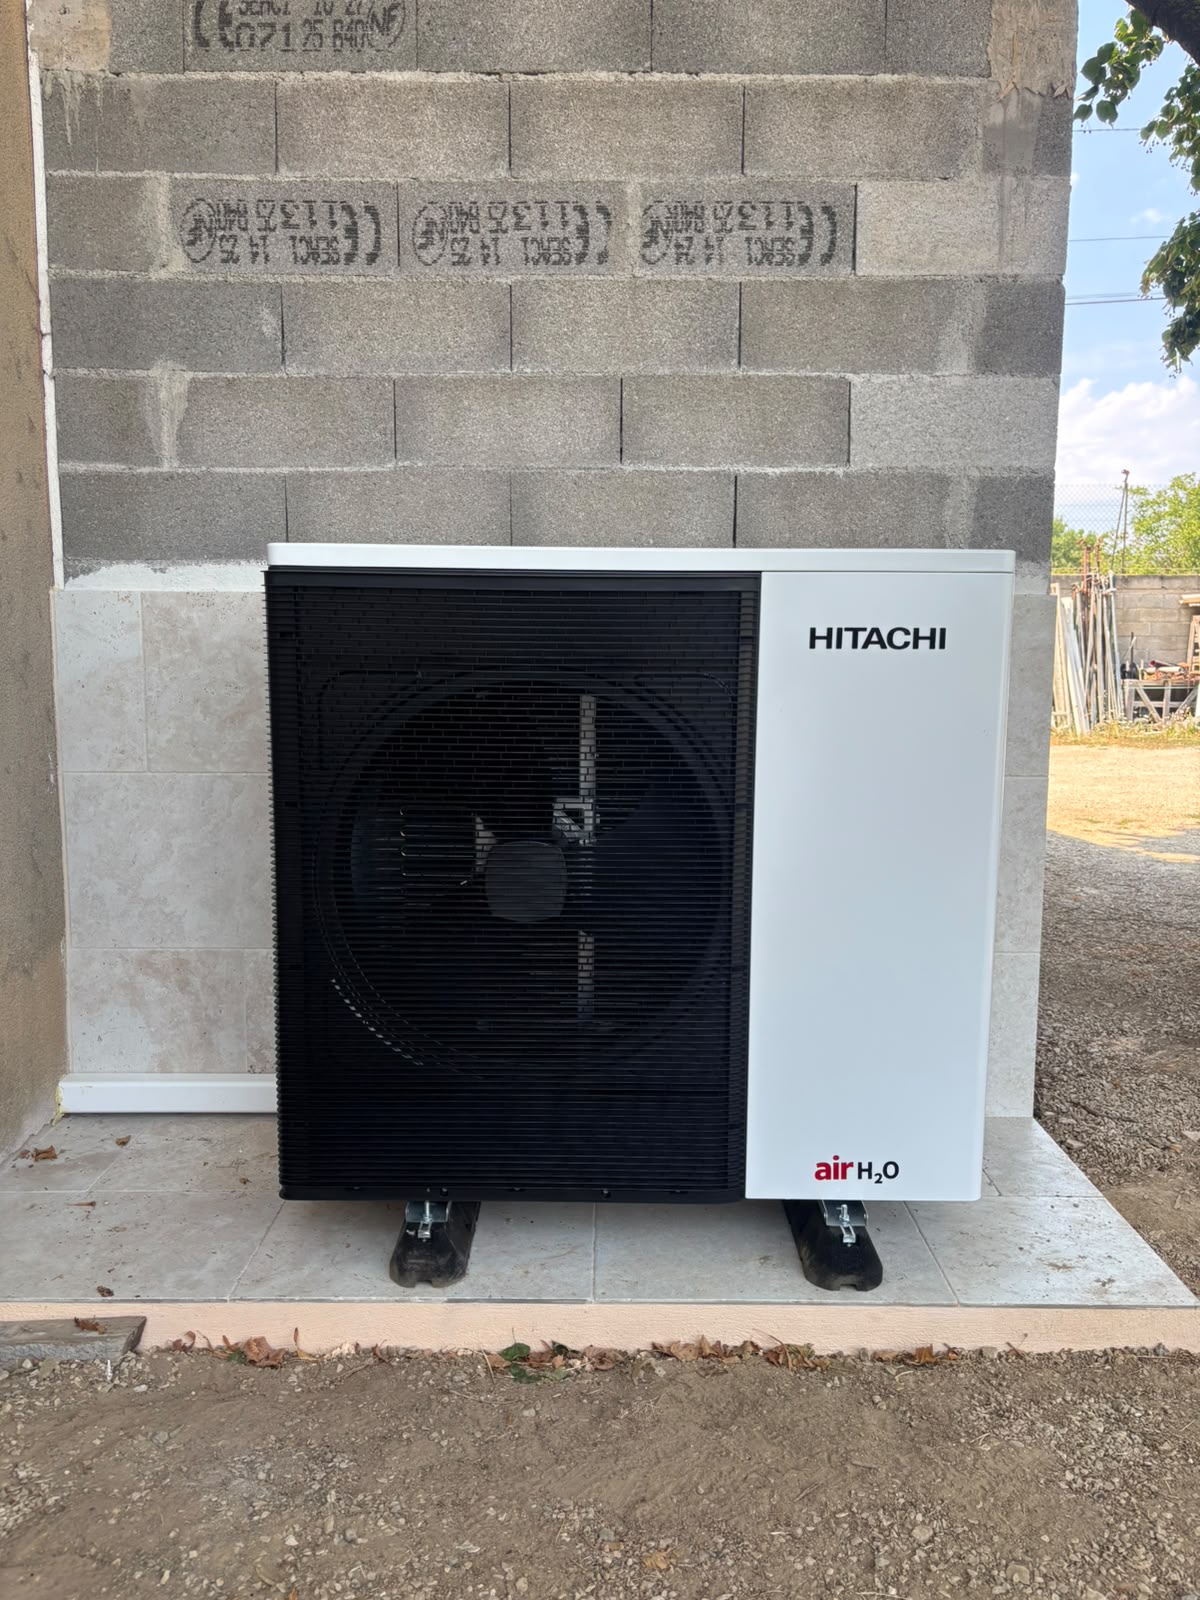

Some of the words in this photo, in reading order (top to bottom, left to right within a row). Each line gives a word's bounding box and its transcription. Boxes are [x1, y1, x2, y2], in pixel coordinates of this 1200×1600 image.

[280, 200, 337, 230] 113
[513, 201, 569, 231] 113
[737, 201, 794, 231] 113
[218, 235, 240, 264] 25
[809, 627, 946, 650] HITACHI
[814, 1155, 854, 1180] air
